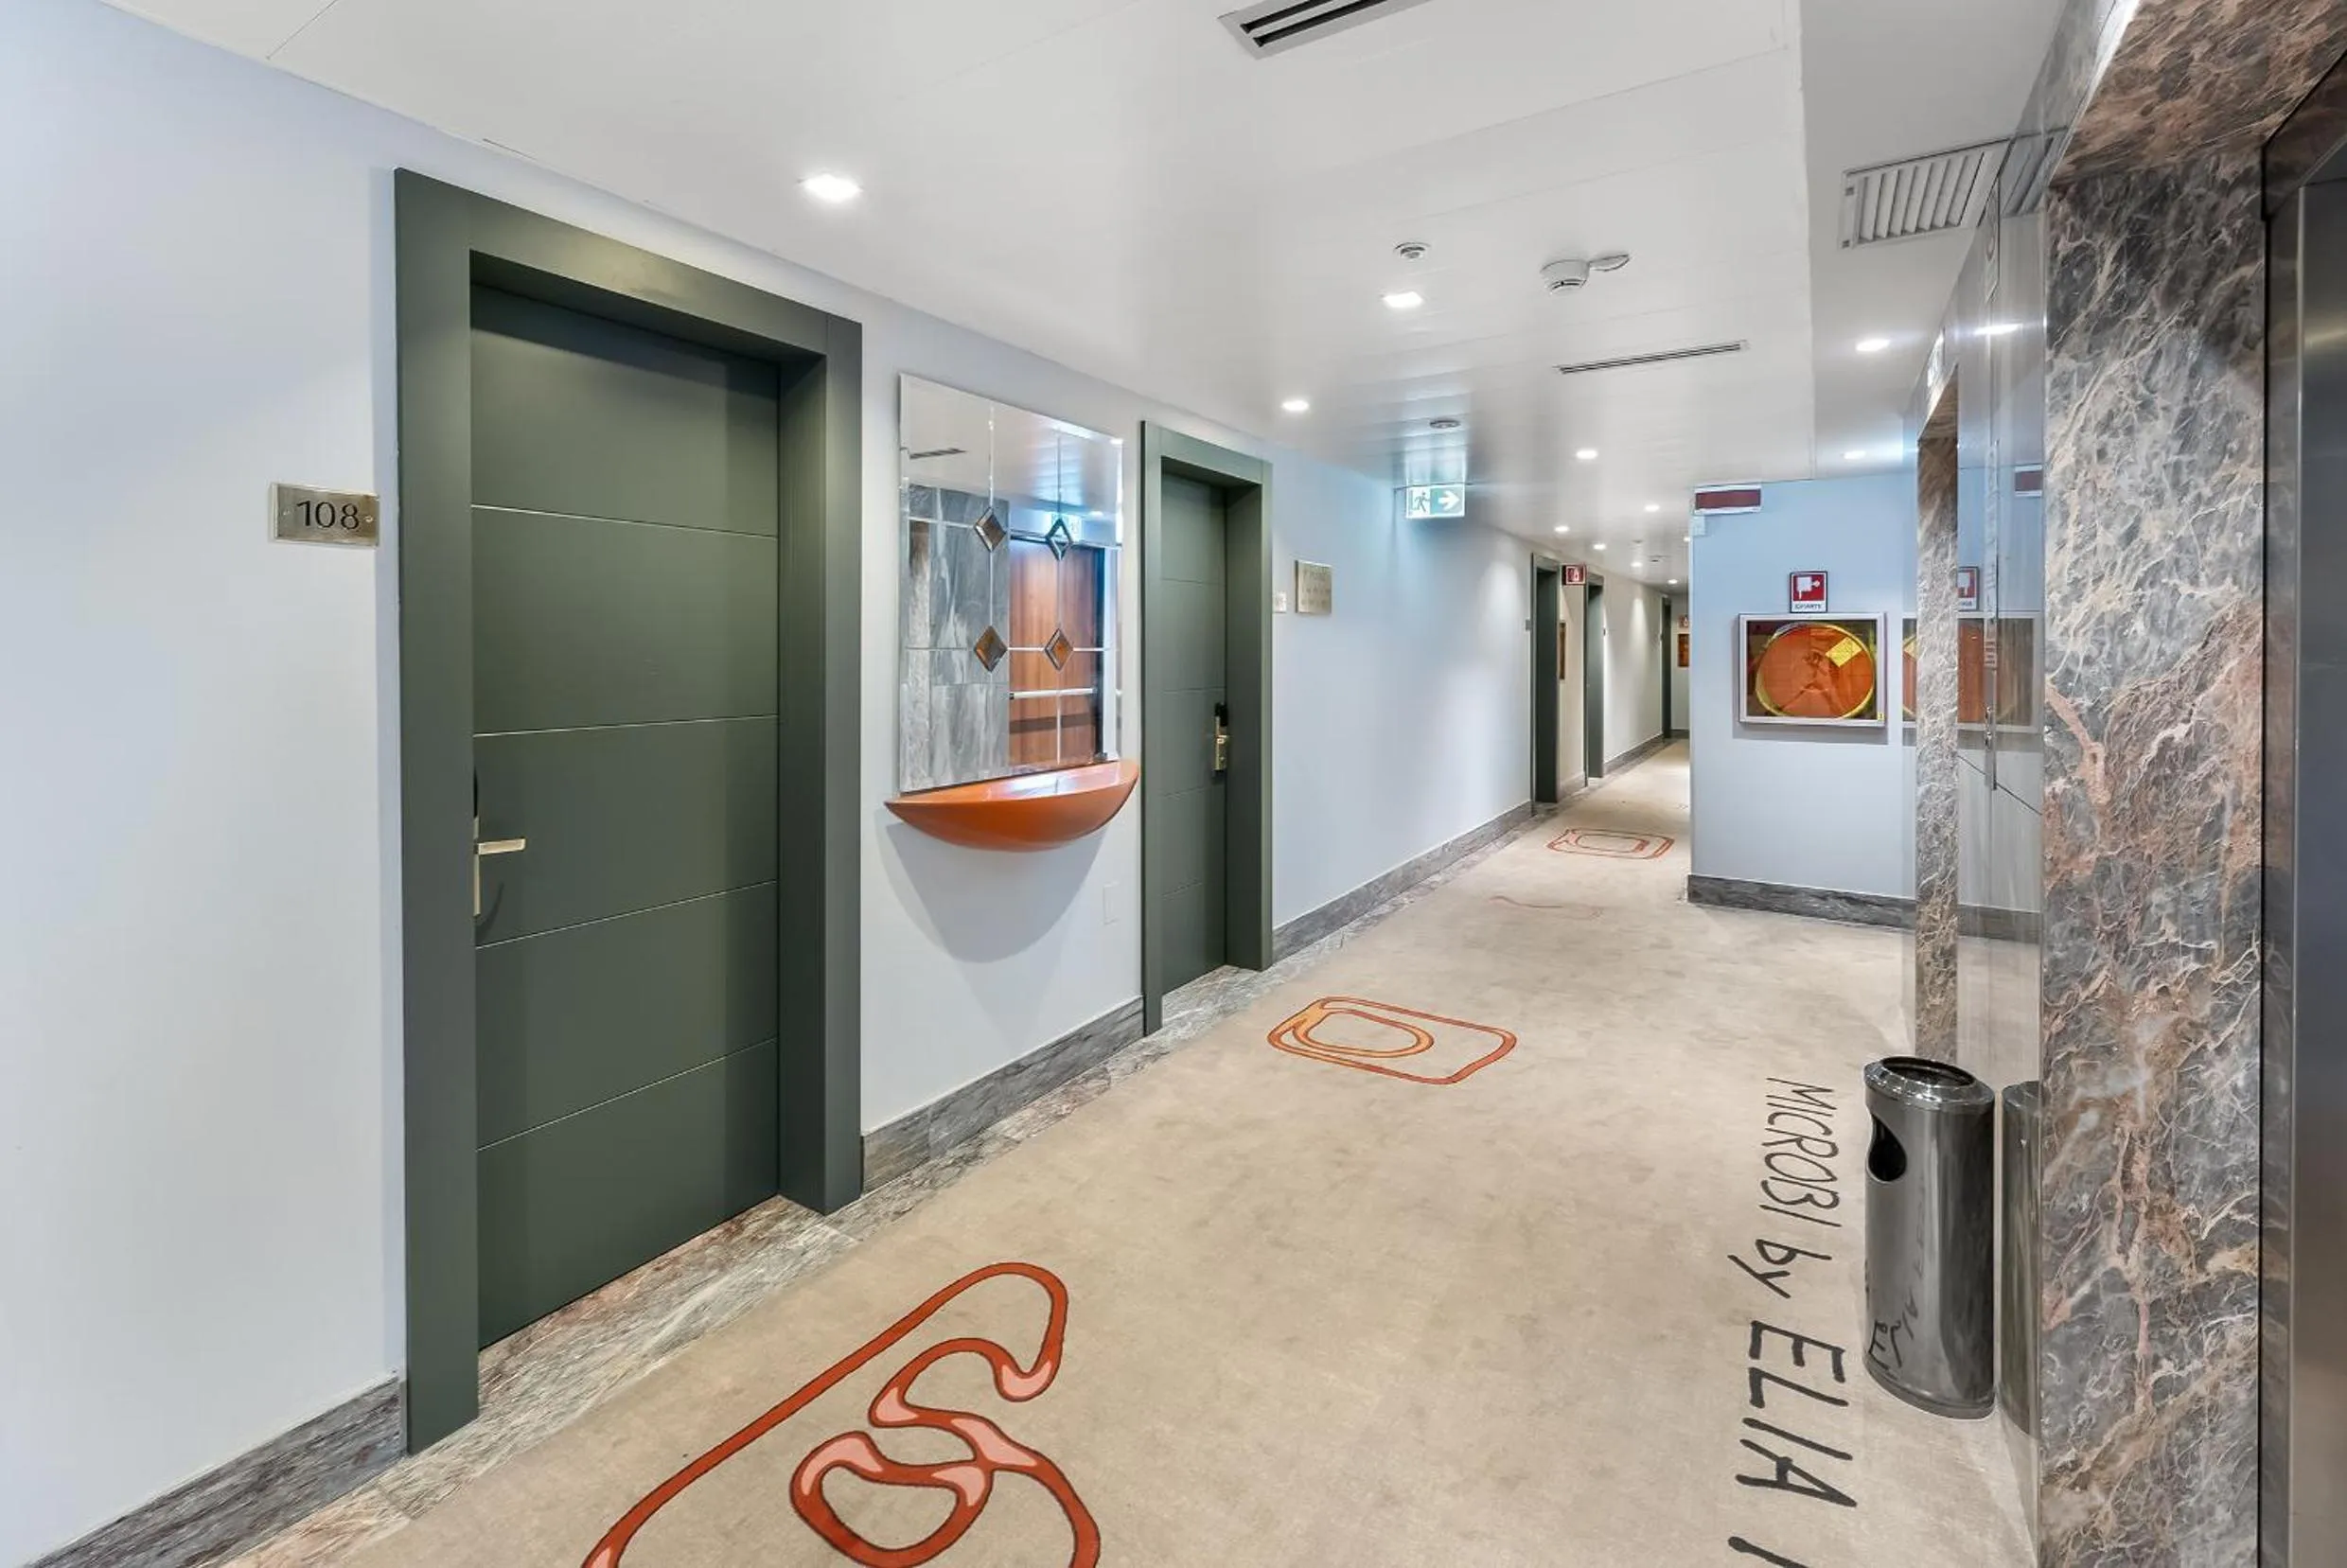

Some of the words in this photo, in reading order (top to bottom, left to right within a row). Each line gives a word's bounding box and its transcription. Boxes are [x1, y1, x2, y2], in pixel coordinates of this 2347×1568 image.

[296, 500, 360, 530] 108
[1759, 1077, 1843, 1227] MICROBI
[1727, 1238, 1832, 1298] by
[1736, 1320, 1858, 1507] ELIA
